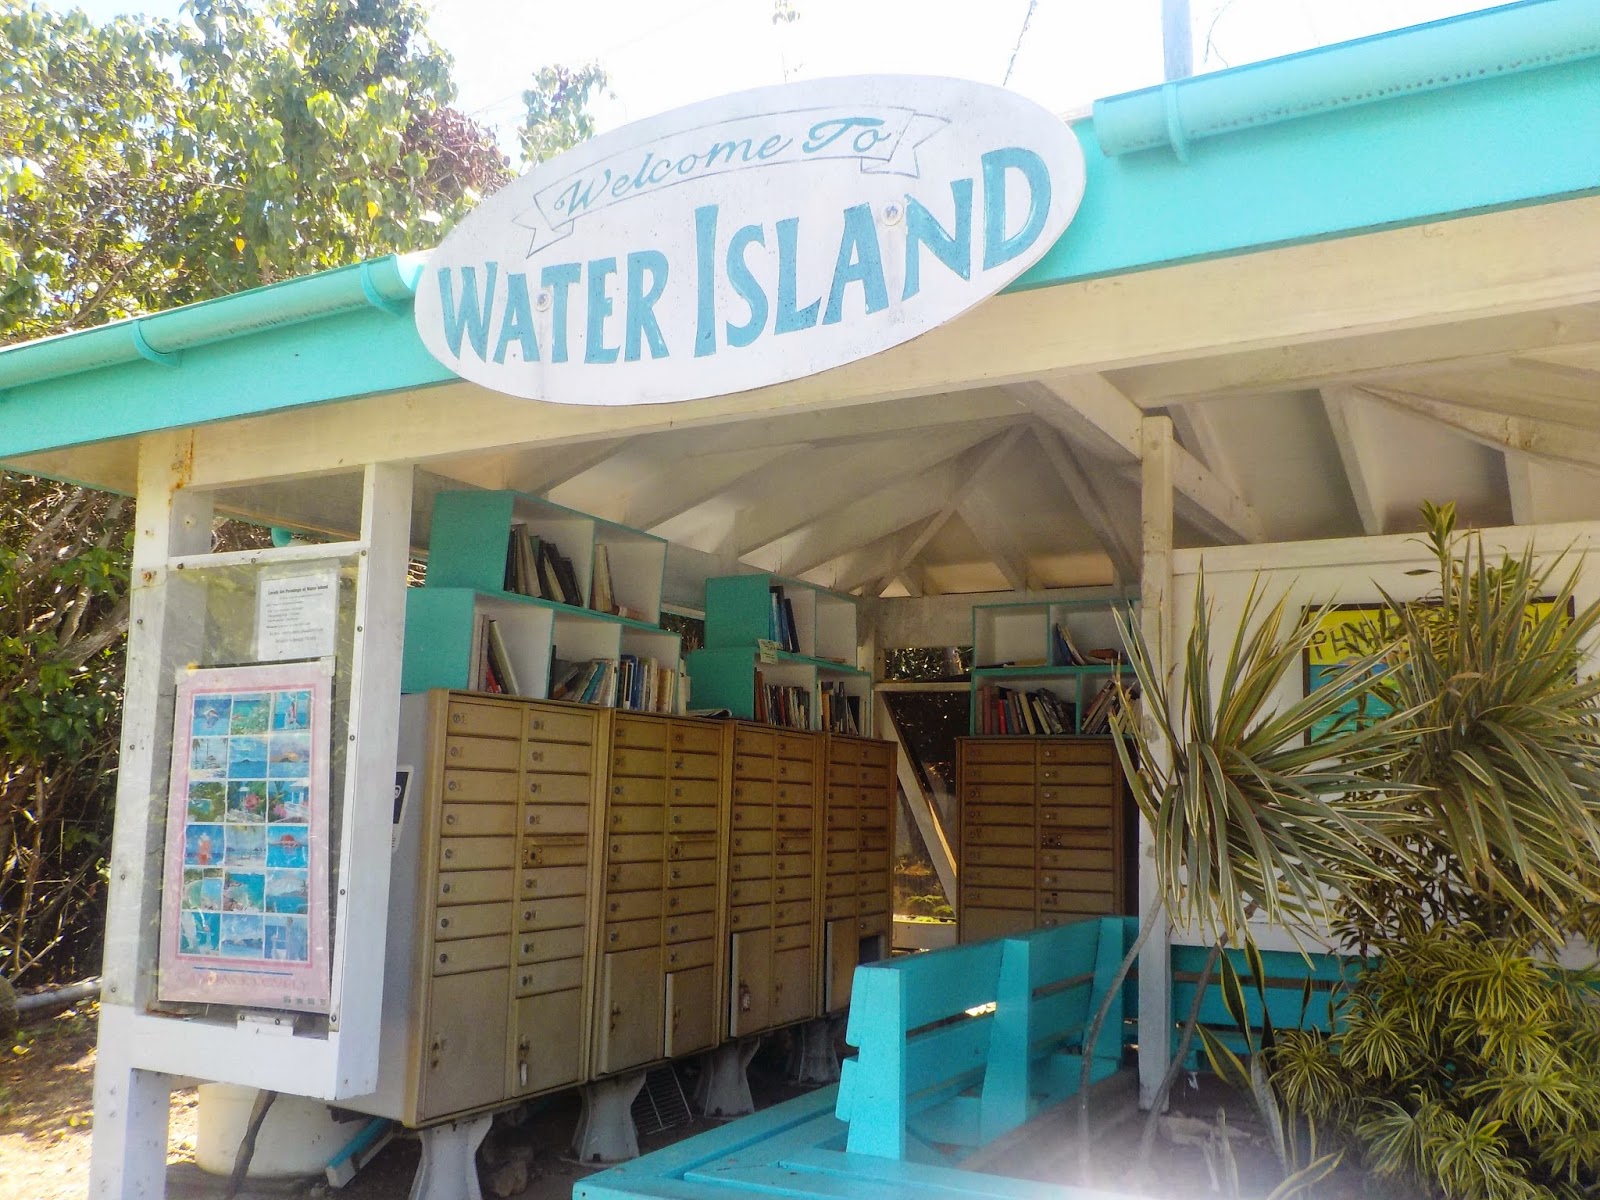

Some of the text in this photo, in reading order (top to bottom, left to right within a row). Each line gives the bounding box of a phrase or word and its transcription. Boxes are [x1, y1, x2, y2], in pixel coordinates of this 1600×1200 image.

[553, 116, 891, 217] Welcome To
[438, 146, 1052, 365] WATER ISLAND
